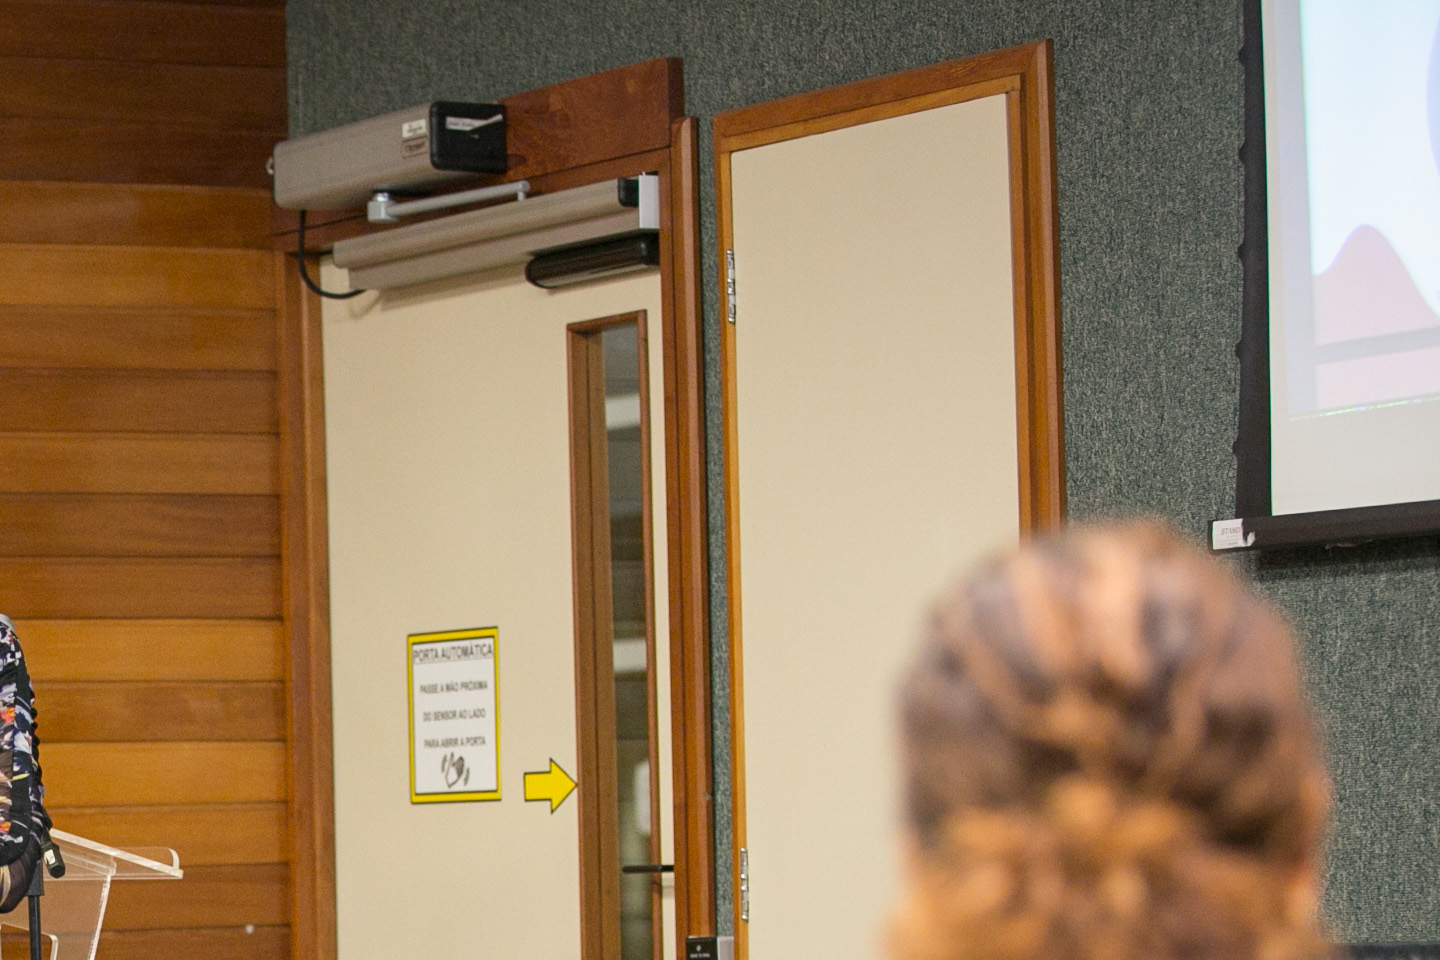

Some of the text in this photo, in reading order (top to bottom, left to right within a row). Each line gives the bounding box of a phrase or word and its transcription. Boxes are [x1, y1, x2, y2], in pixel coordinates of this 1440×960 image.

[413, 641, 493, 662] PORTA AUTOMÁTICA
[446, 681, 459, 693] MÃO
[423, 708, 486, 722] DO SENSOR AO LADO
[424, 738, 439, 748] PARA
[441, 737, 458, 747] ABRIR
[466, 736, 486, 746] PORTA
